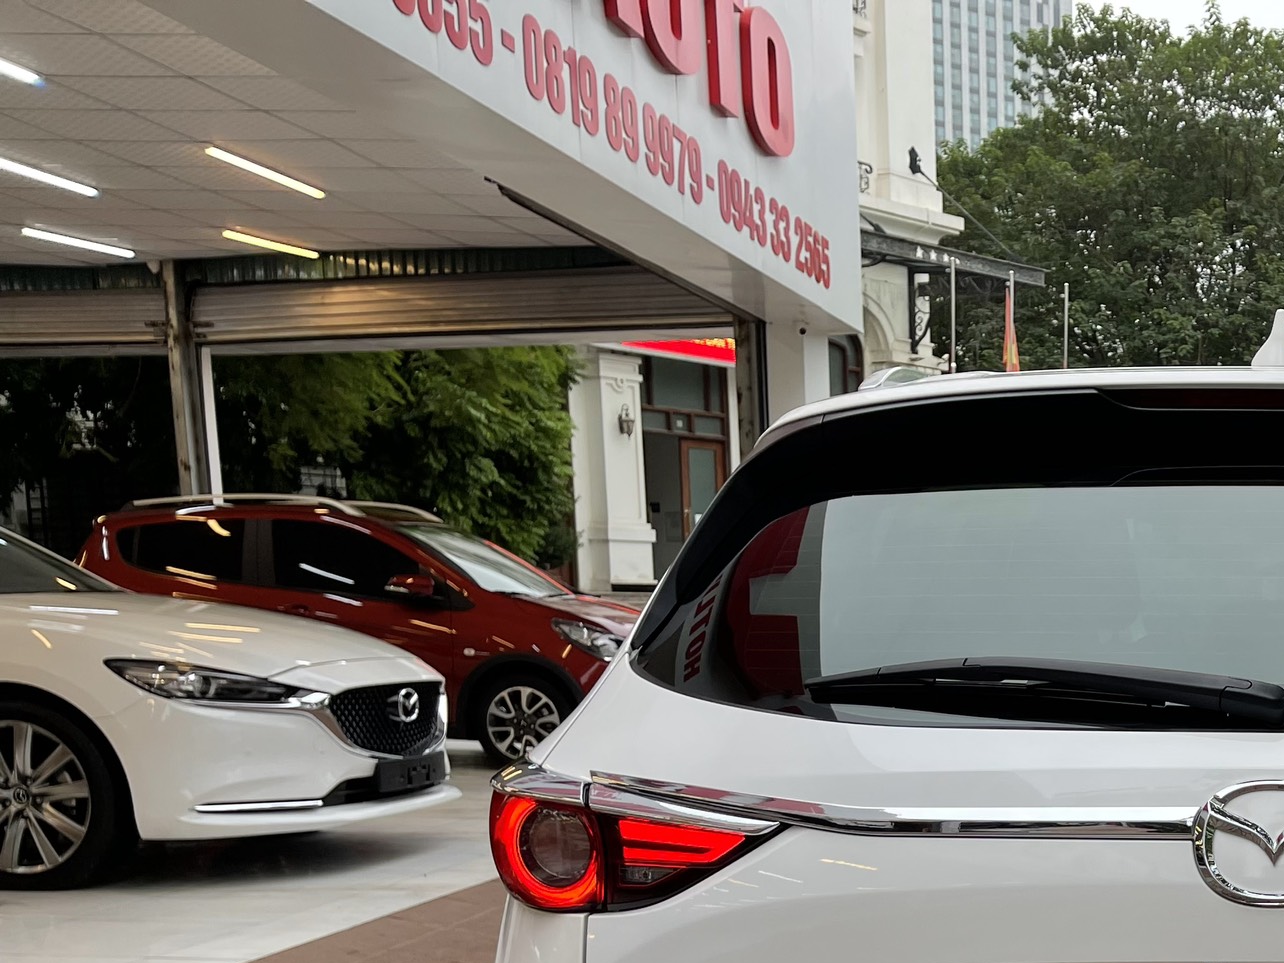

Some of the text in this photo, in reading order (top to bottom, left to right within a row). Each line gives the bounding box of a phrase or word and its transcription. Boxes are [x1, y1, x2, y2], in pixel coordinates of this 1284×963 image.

[522, 13, 600, 138] 0819
[603, 72, 640, 164] 89
[642, 101, 703, 206] 9979
[717, 158, 768, 248] 0943
[769, 196, 792, 264] 33
[794, 215, 831, 290] 2565
[603, 0, 795, 158] UTO
